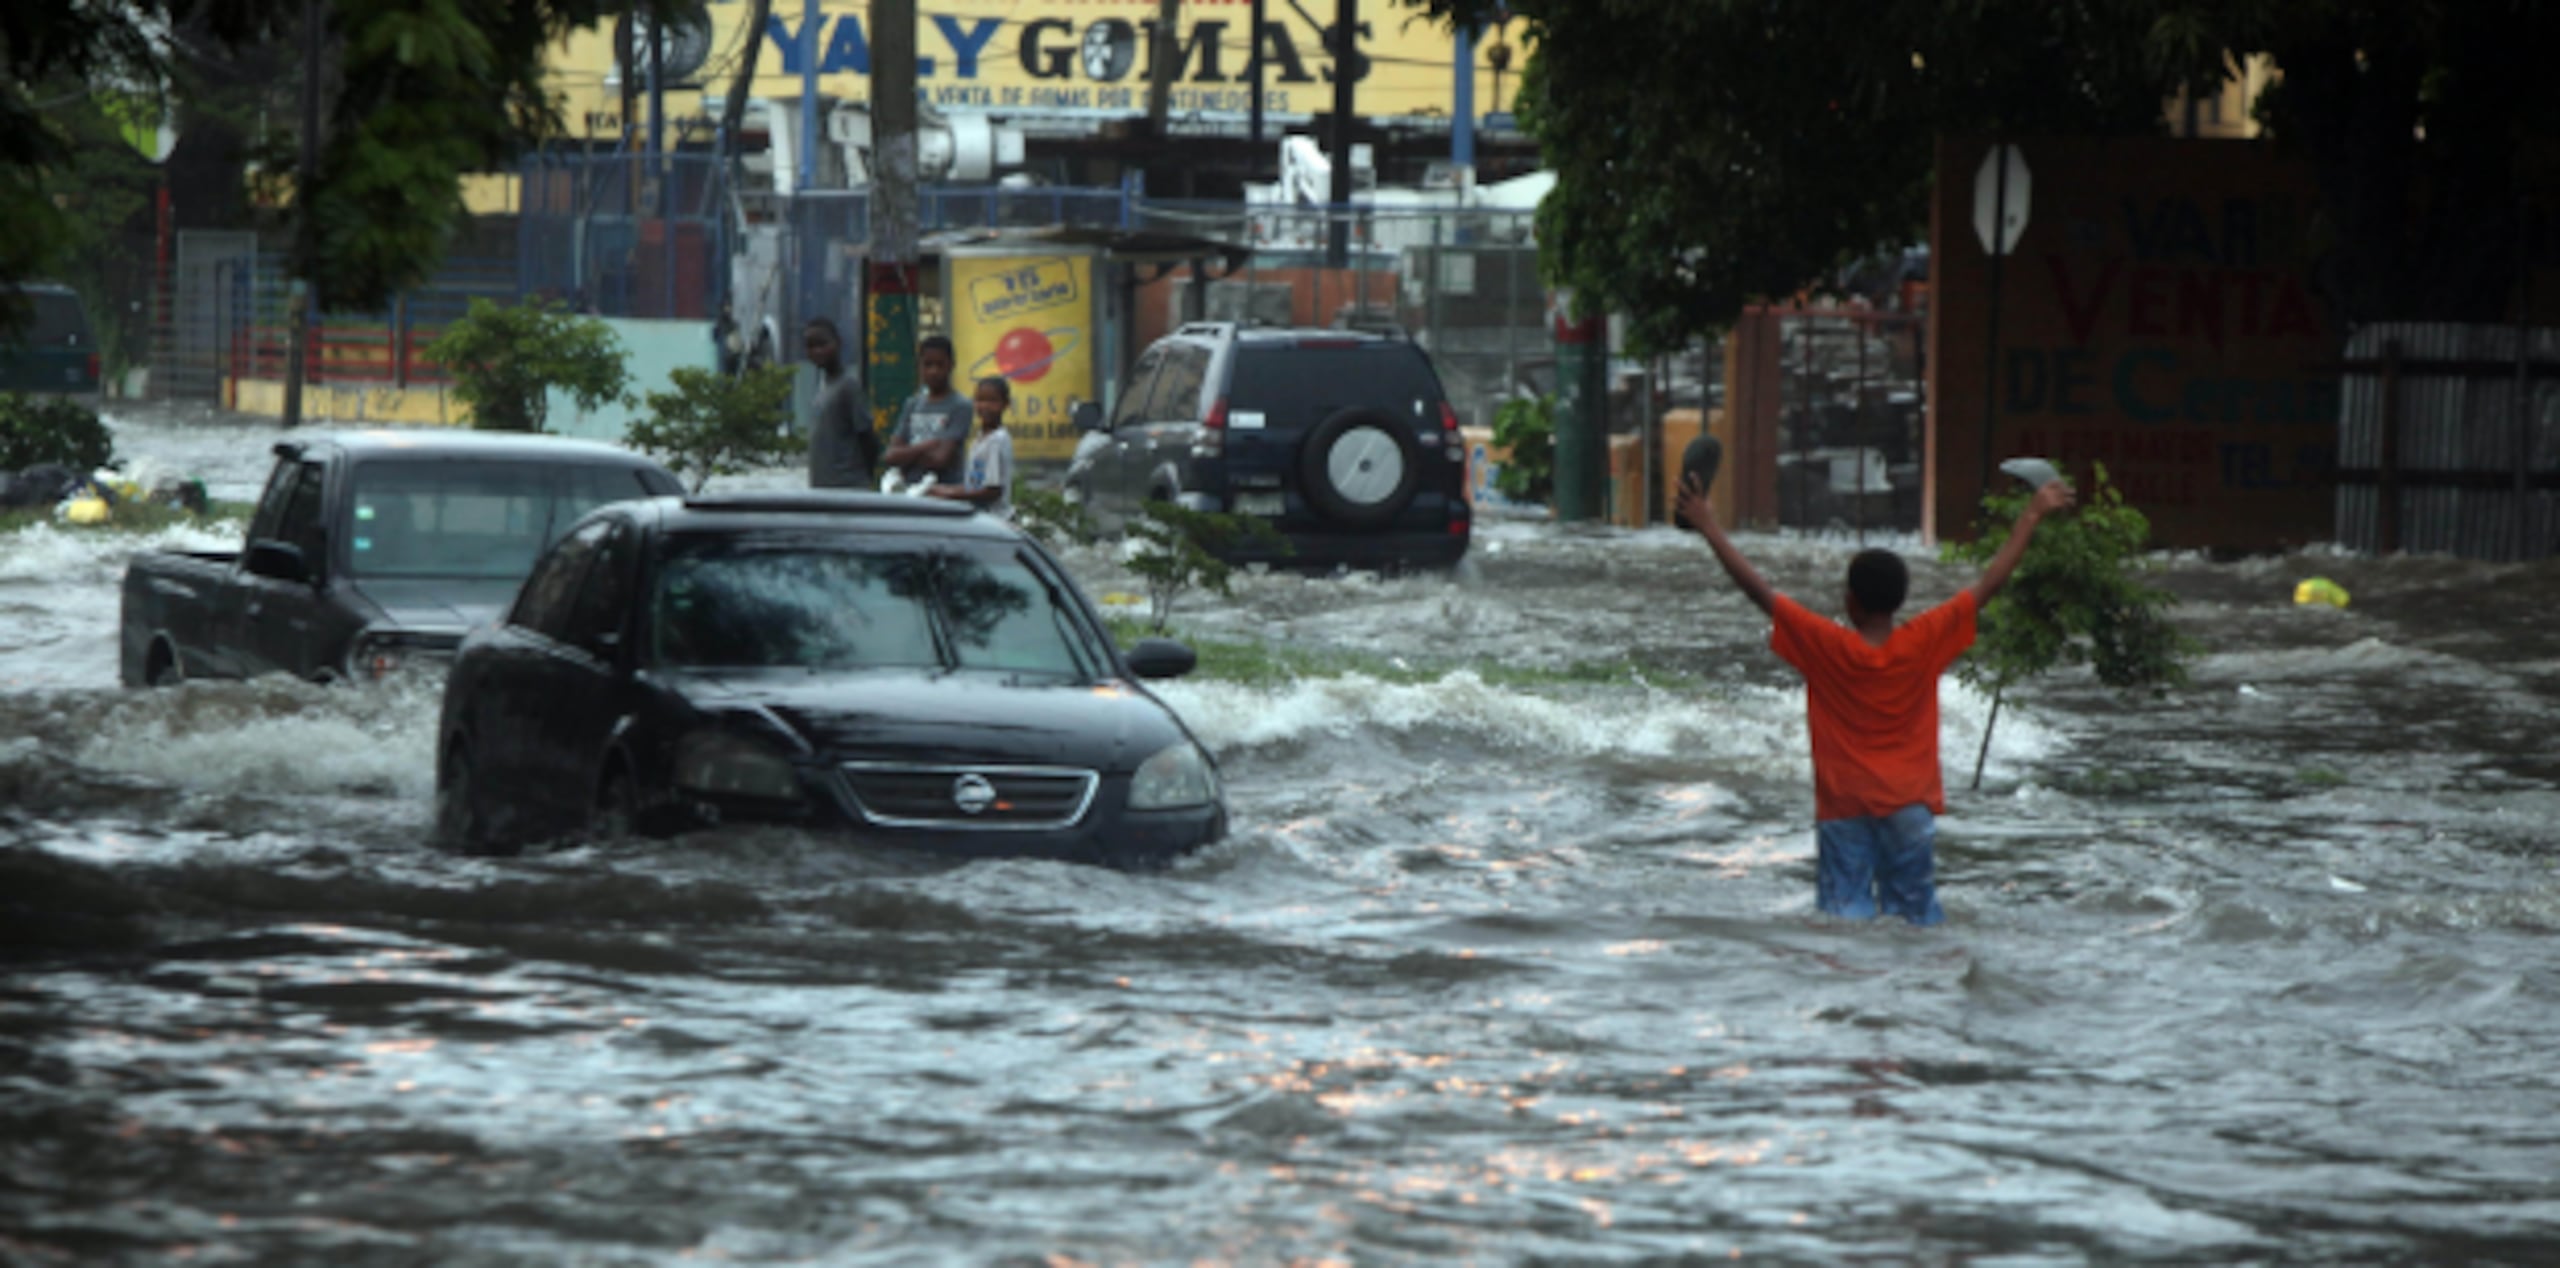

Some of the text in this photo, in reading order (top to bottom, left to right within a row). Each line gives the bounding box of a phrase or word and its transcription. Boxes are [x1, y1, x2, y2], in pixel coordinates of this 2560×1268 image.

[1018, 16, 1374, 84] GOMAS
[936, 85, 991, 106] VENTA
[1001, 85, 1023, 106] DE
[1030, 86, 1089, 108] GOMAS
[1097, 86, 1132, 109] POR
[1140, 87, 1289, 112] CNTENEDOES
[2044, 254, 2324, 350] VENTA
[2003, 346, 2094, 416] DE
